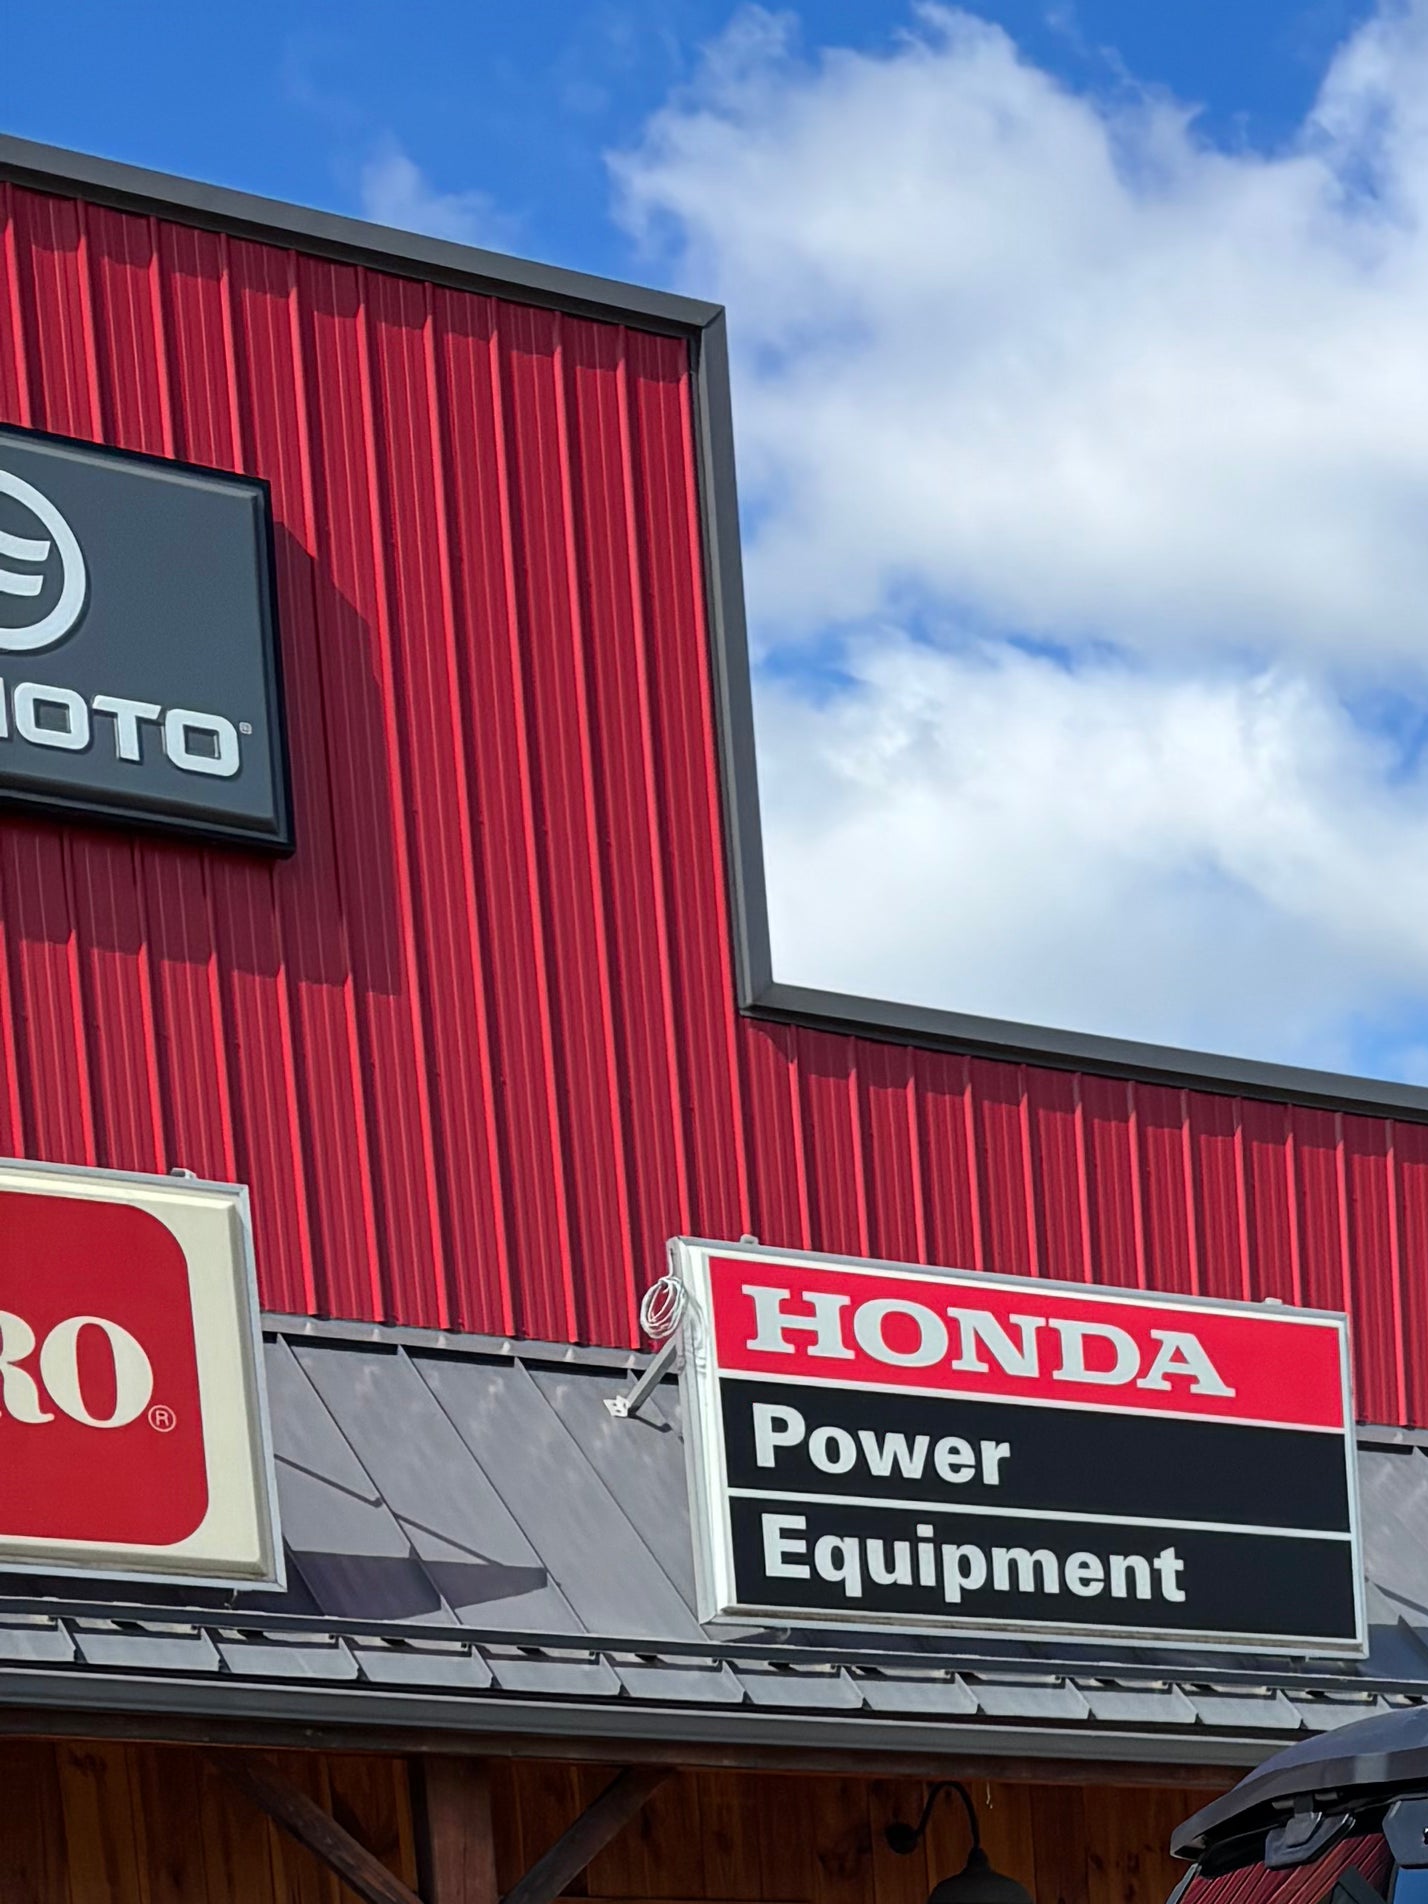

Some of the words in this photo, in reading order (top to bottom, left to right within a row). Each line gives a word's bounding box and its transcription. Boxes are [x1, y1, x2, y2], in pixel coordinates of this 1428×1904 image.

[0, 677, 240, 777] OTO
[742, 1284, 1236, 1397] HONDA
[752, 1402, 1011, 1486] Power
[761, 1512, 1186, 1602] Equipment
